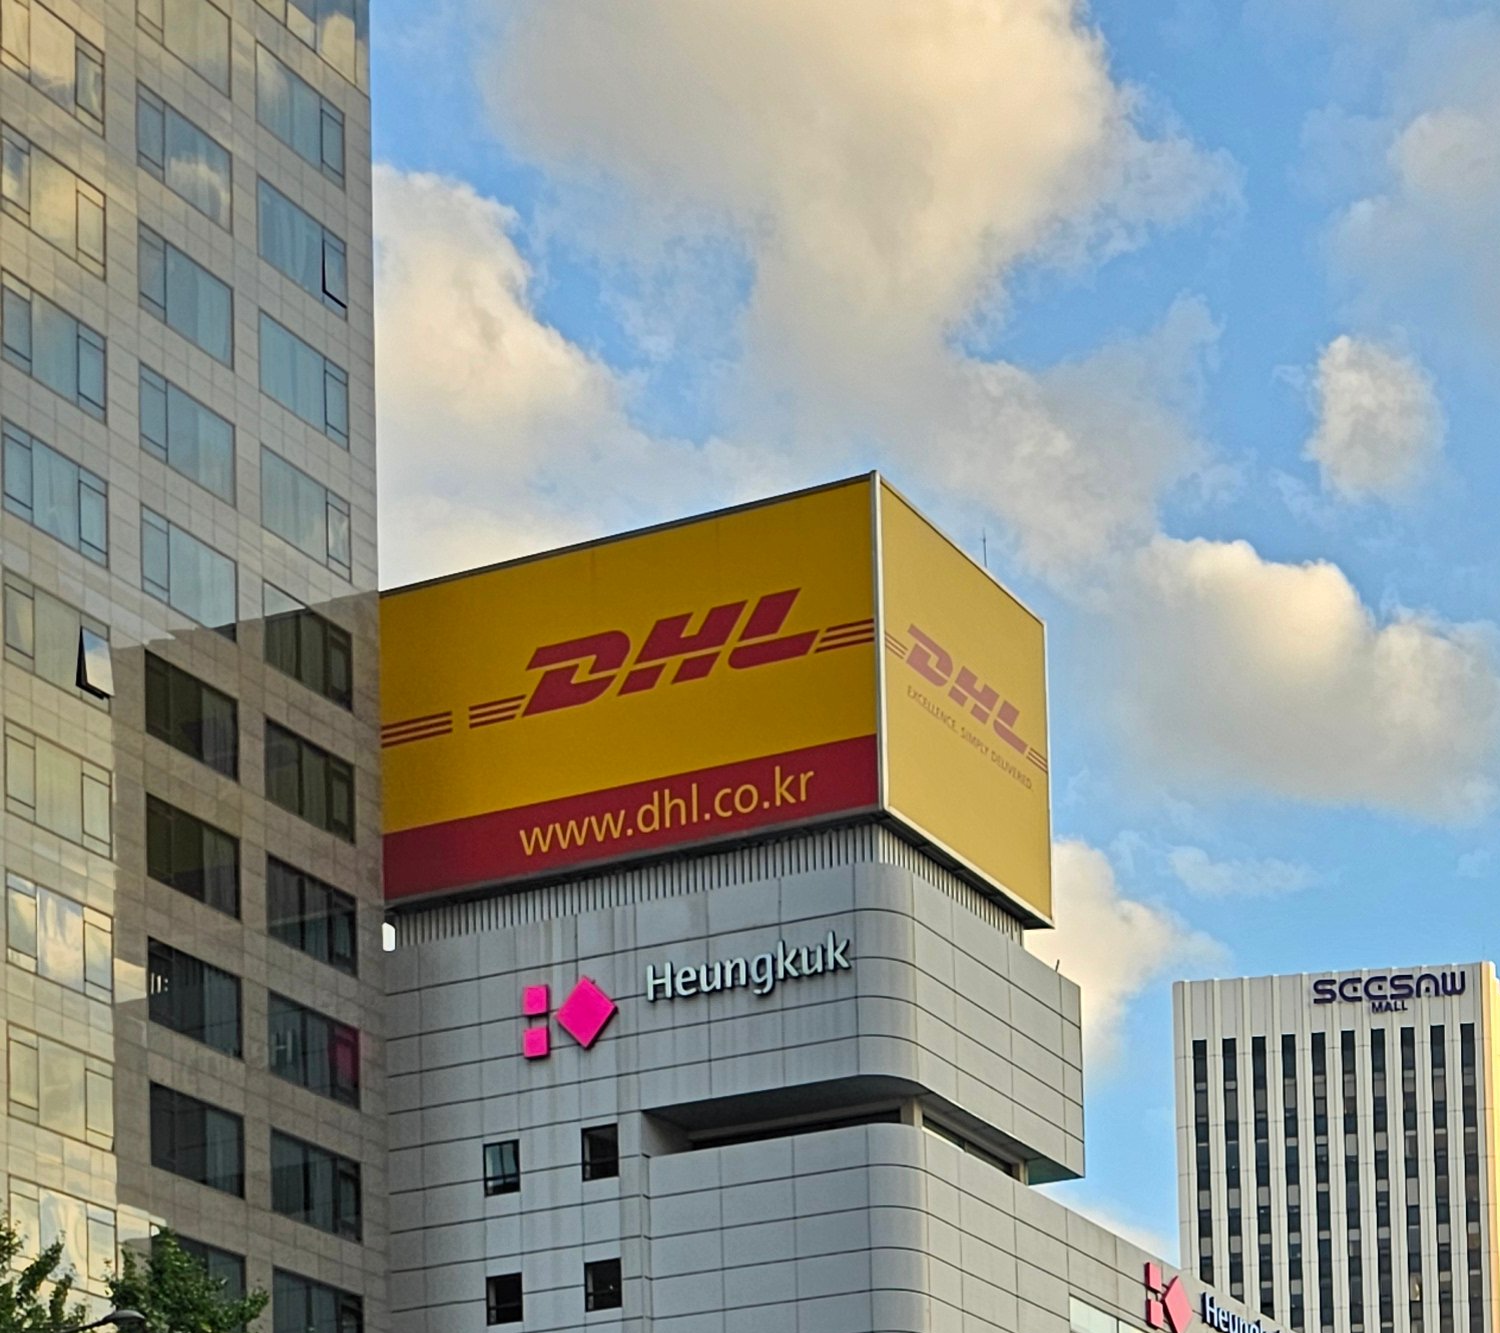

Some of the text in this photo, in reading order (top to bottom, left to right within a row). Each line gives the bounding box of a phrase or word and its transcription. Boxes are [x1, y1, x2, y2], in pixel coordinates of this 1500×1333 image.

[522, 588, 819, 717] DHL
[905, 624, 1028, 755] DHL
[519, 766, 814, 856] www.dhl.co.kr
[644, 931, 852, 1002] Heungkuk
[1371, 1001, 1408, 1013] MALL
